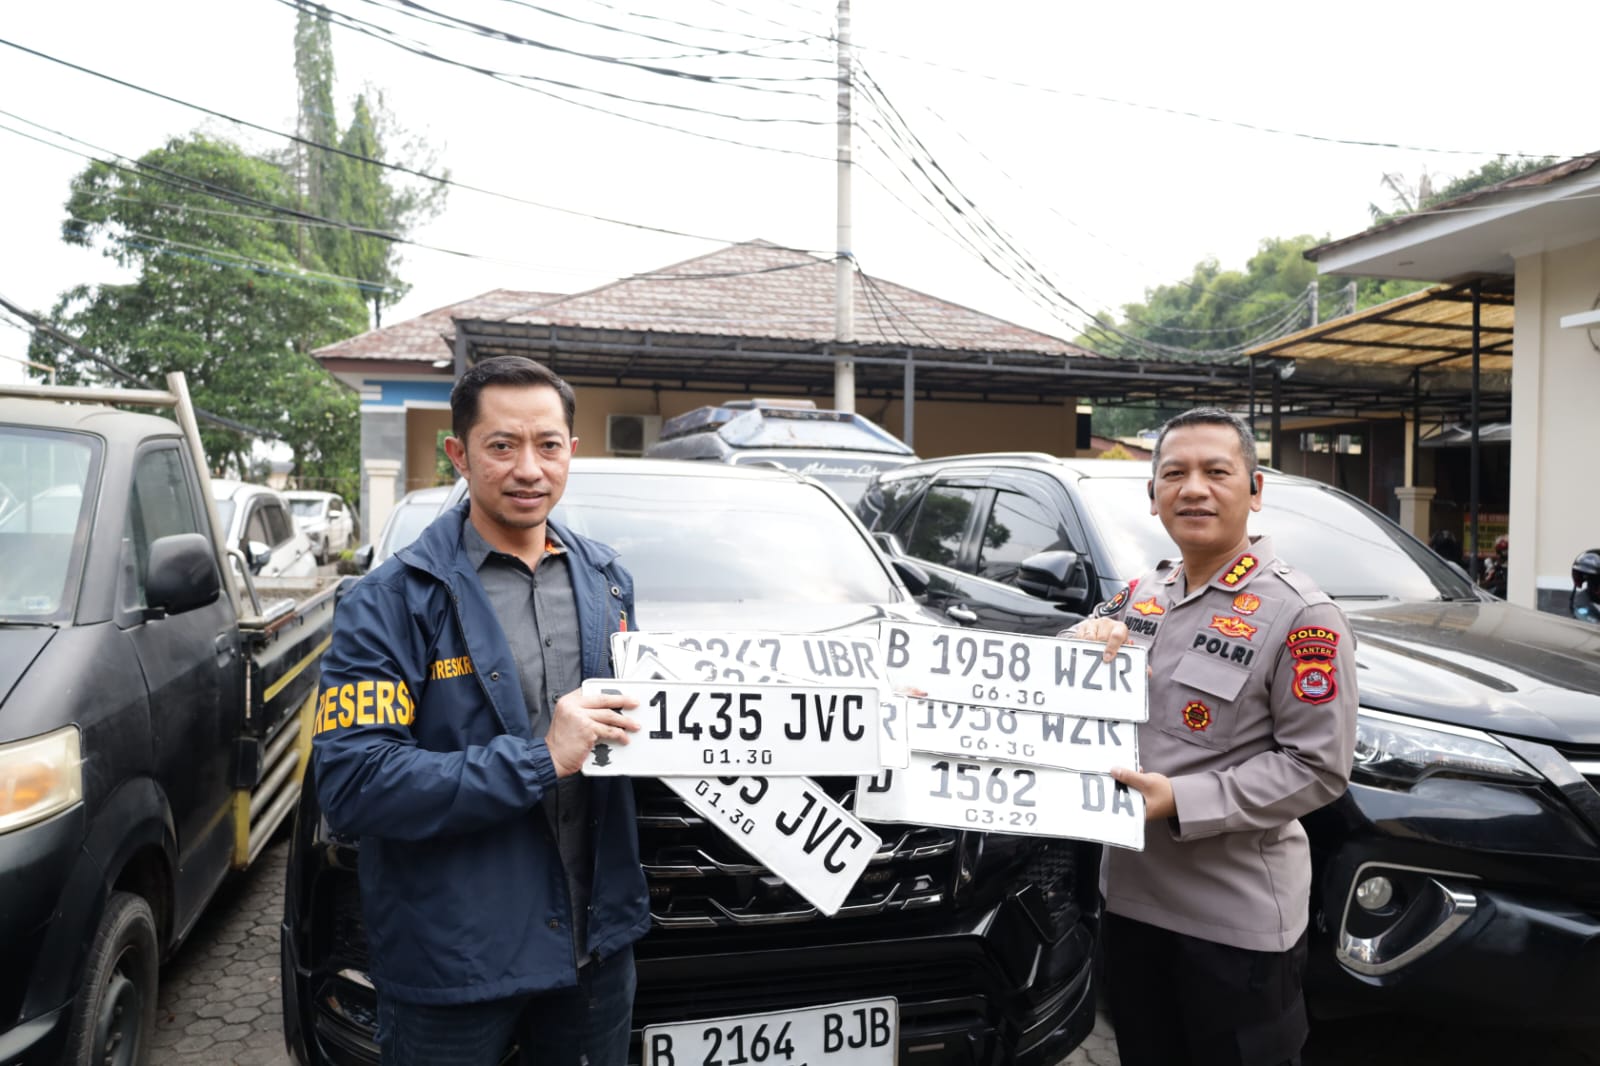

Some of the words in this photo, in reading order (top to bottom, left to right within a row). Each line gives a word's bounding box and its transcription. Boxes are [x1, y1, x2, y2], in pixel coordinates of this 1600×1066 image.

[1193, 633, 1254, 666] POLRI
[1289, 629, 1334, 642] POLDA
[1296, 647, 1331, 655] BANTEN
[803, 639, 880, 680] UBR
[886, 628, 910, 668] B
[930, 634, 1031, 682] 1958
[1054, 646, 1132, 692] WZR
[972, 684, 1046, 705] 06.30
[649, 691, 763, 741] 1435
[784, 693, 865, 742] JVC
[703, 749, 773, 765] 01.30
[929, 760, 1037, 807] 1562
[695, 779, 756, 835] 01.30
[965, 808, 1038, 827] 03.29
[775, 790, 863, 874] JVC
[652, 1033, 675, 1066] B
[703, 1021, 795, 1066] 2164
[823, 1007, 891, 1053] BJB
